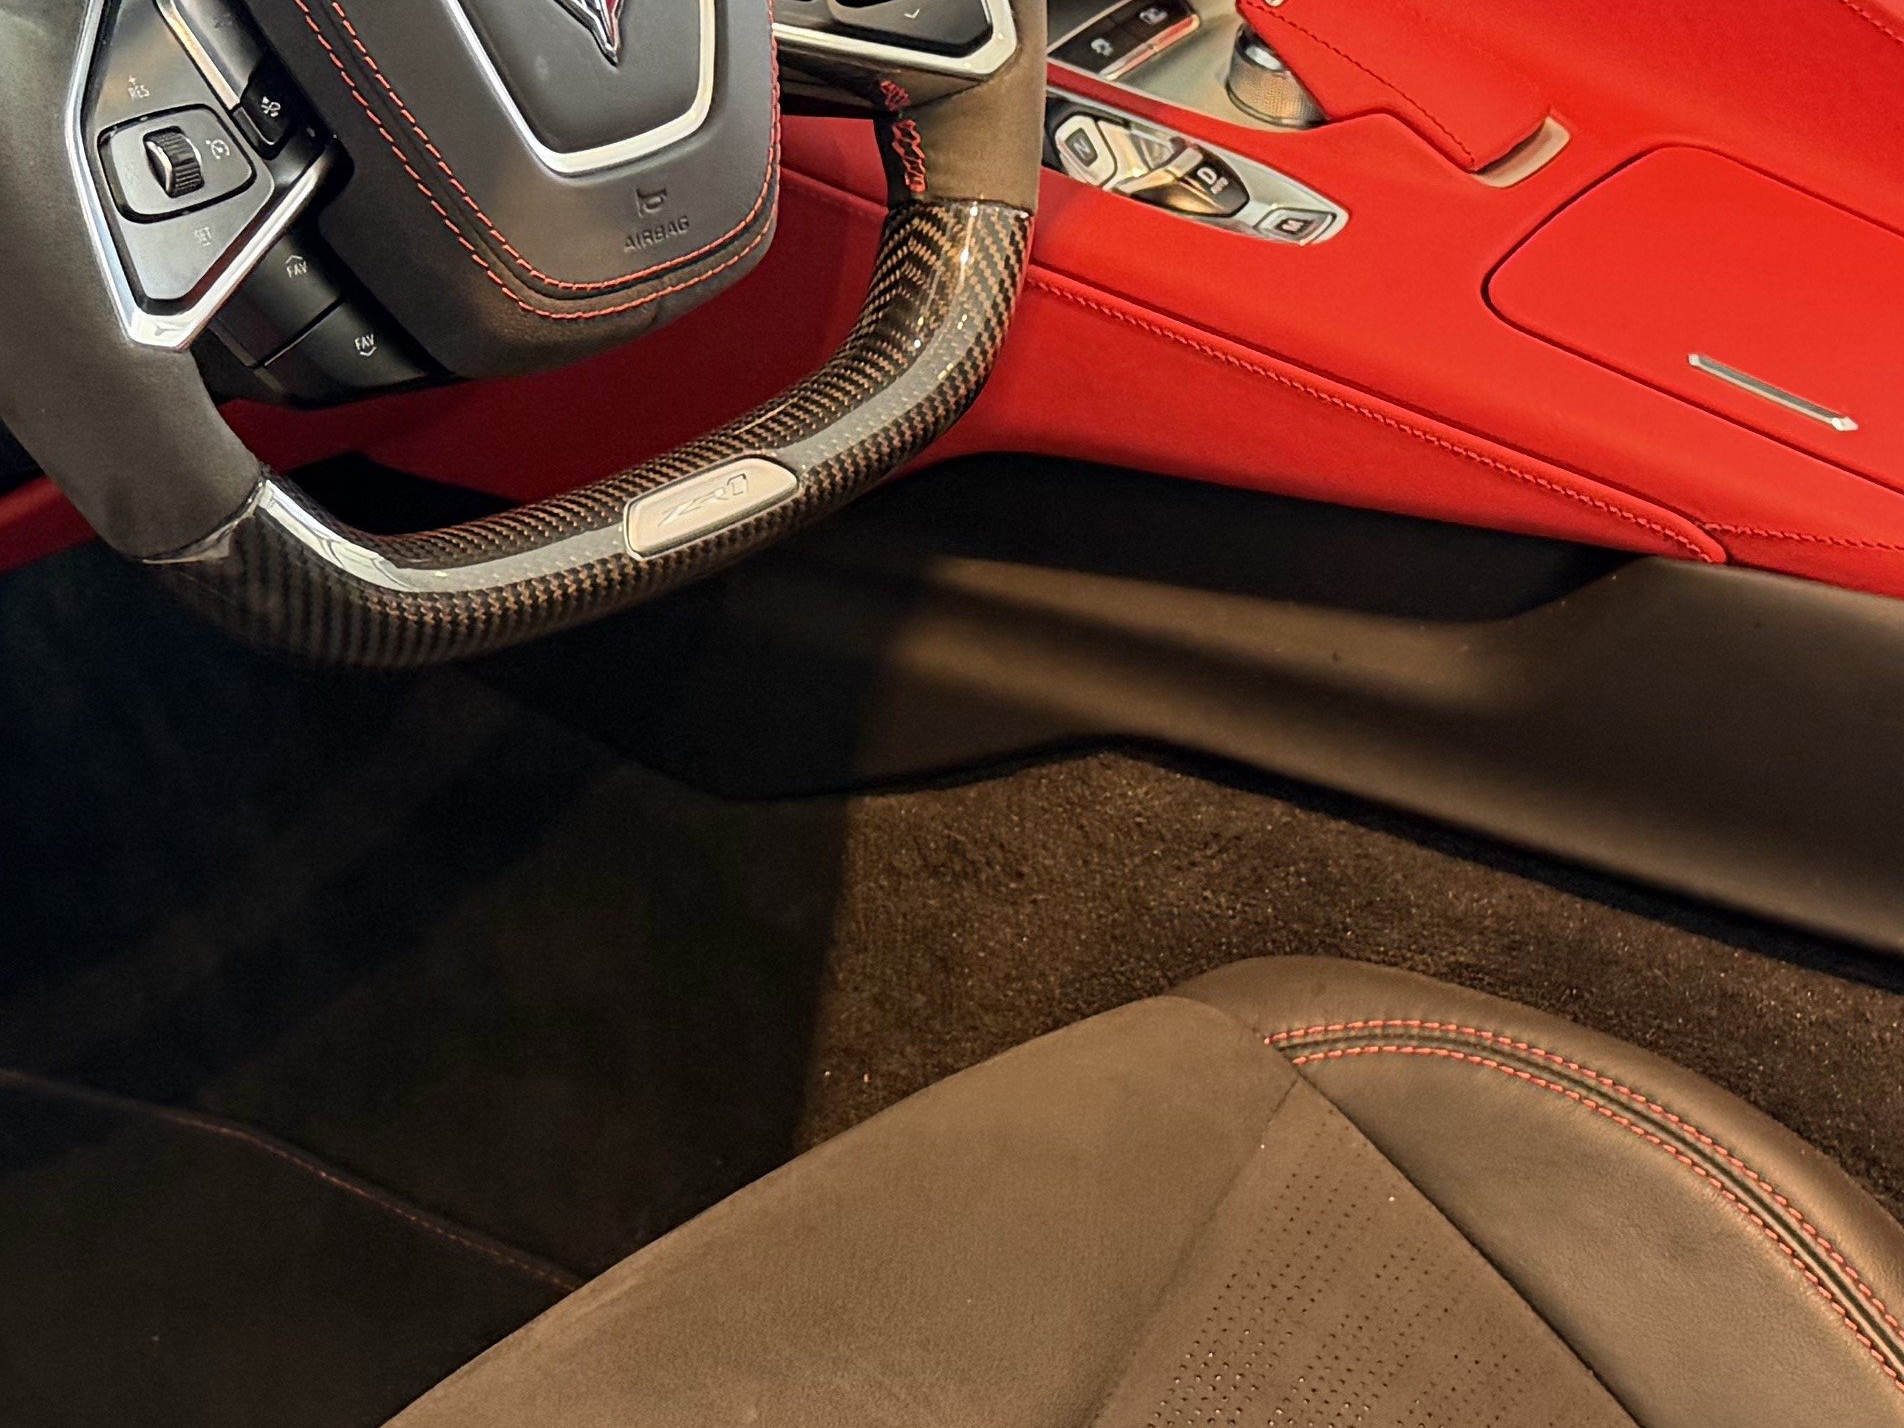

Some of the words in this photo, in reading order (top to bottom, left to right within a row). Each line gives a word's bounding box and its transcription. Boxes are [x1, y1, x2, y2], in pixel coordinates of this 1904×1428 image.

[623, 215, 690, 253] AIRBAG
[286, 259, 309, 278] FAV
[354, 332, 376, 351] FAV
